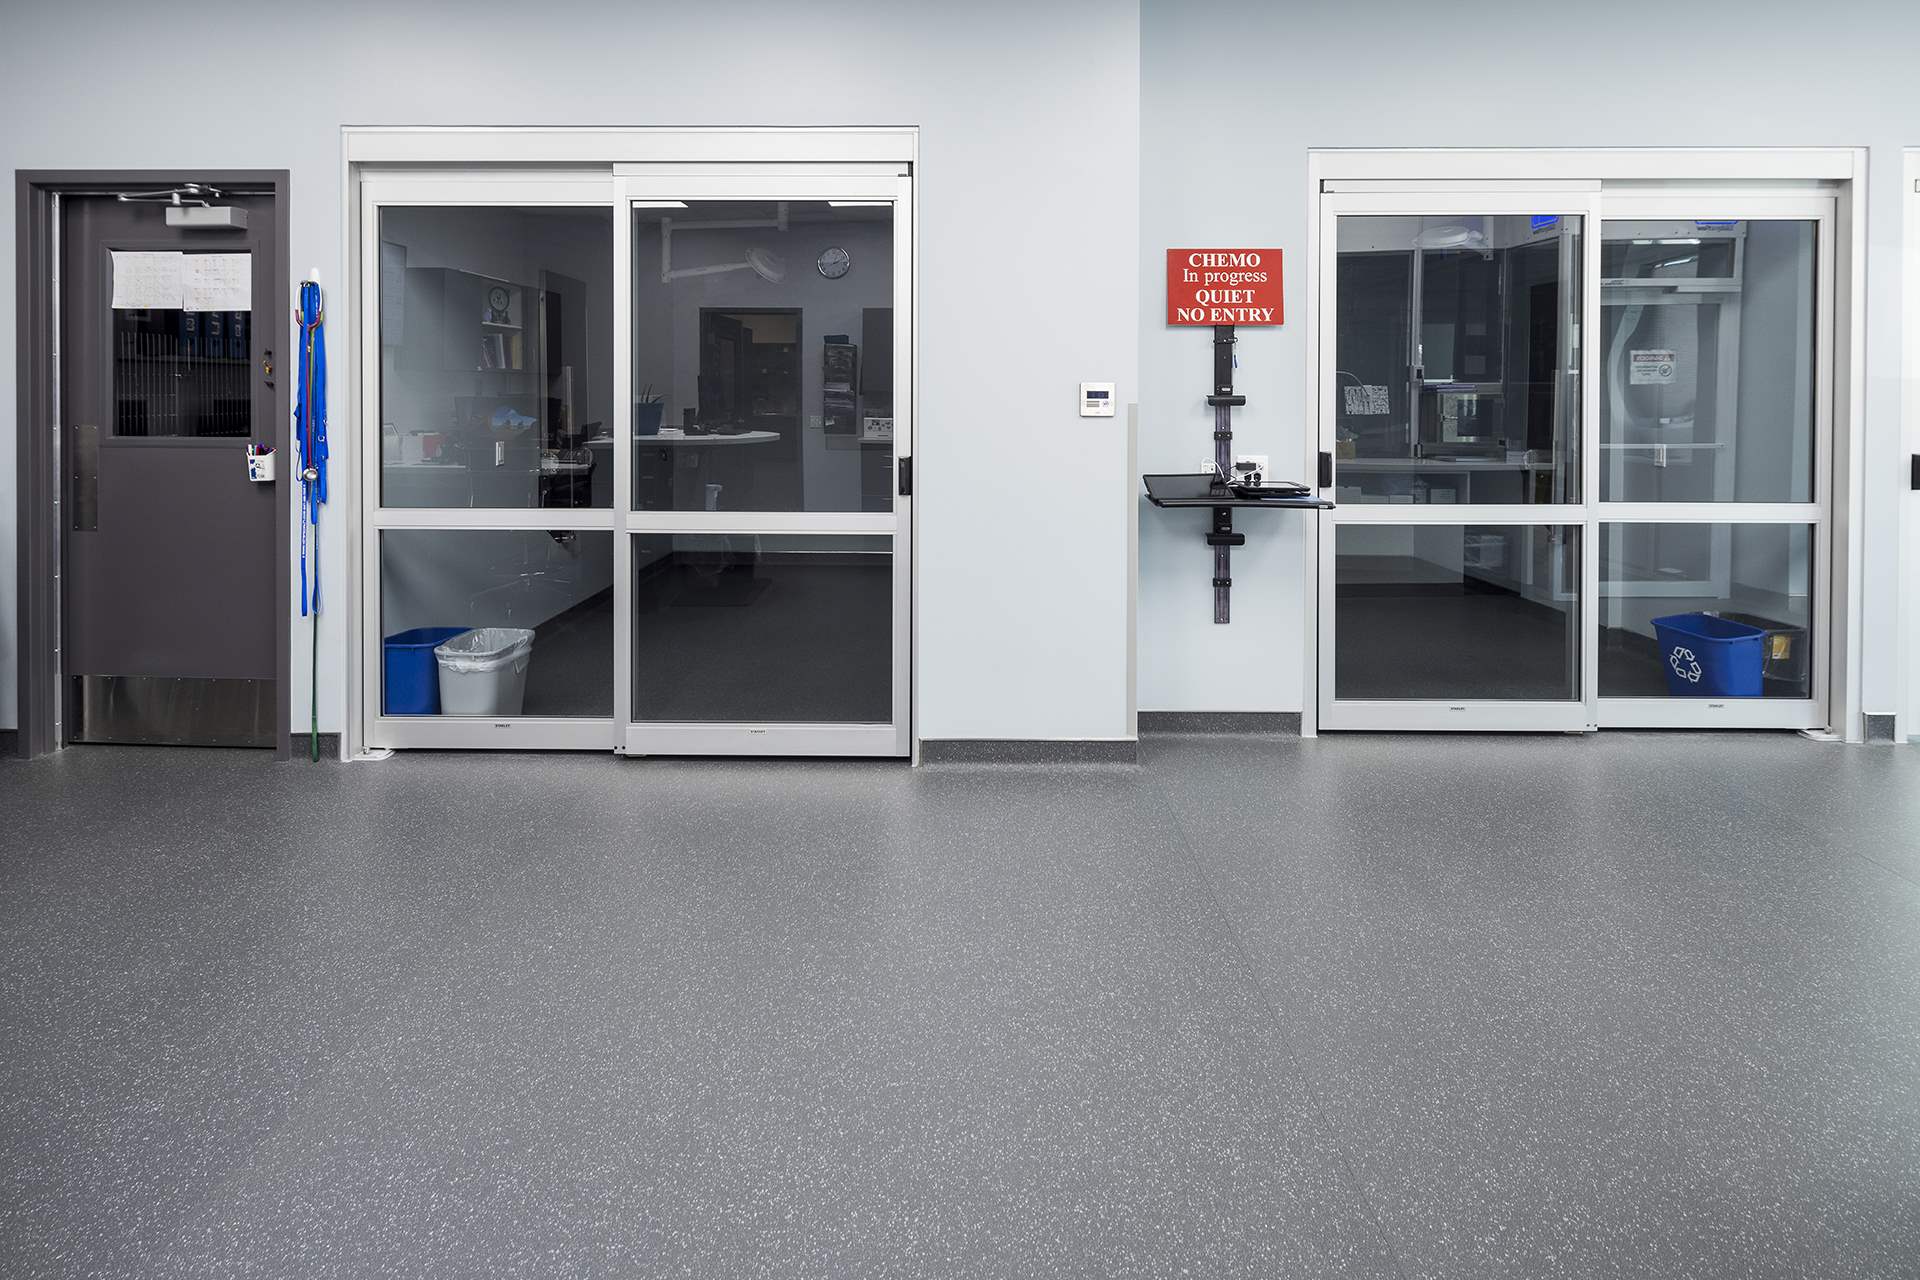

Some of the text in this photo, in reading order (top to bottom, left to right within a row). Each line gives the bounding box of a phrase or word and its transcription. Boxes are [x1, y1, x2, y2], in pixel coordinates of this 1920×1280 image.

[1188, 253, 1261, 268] CHEMO
[1183, 268, 1268, 286] In progress
[1195, 289, 1256, 306] QUIET
[1176, 307, 1274, 322] NO ENTRY
